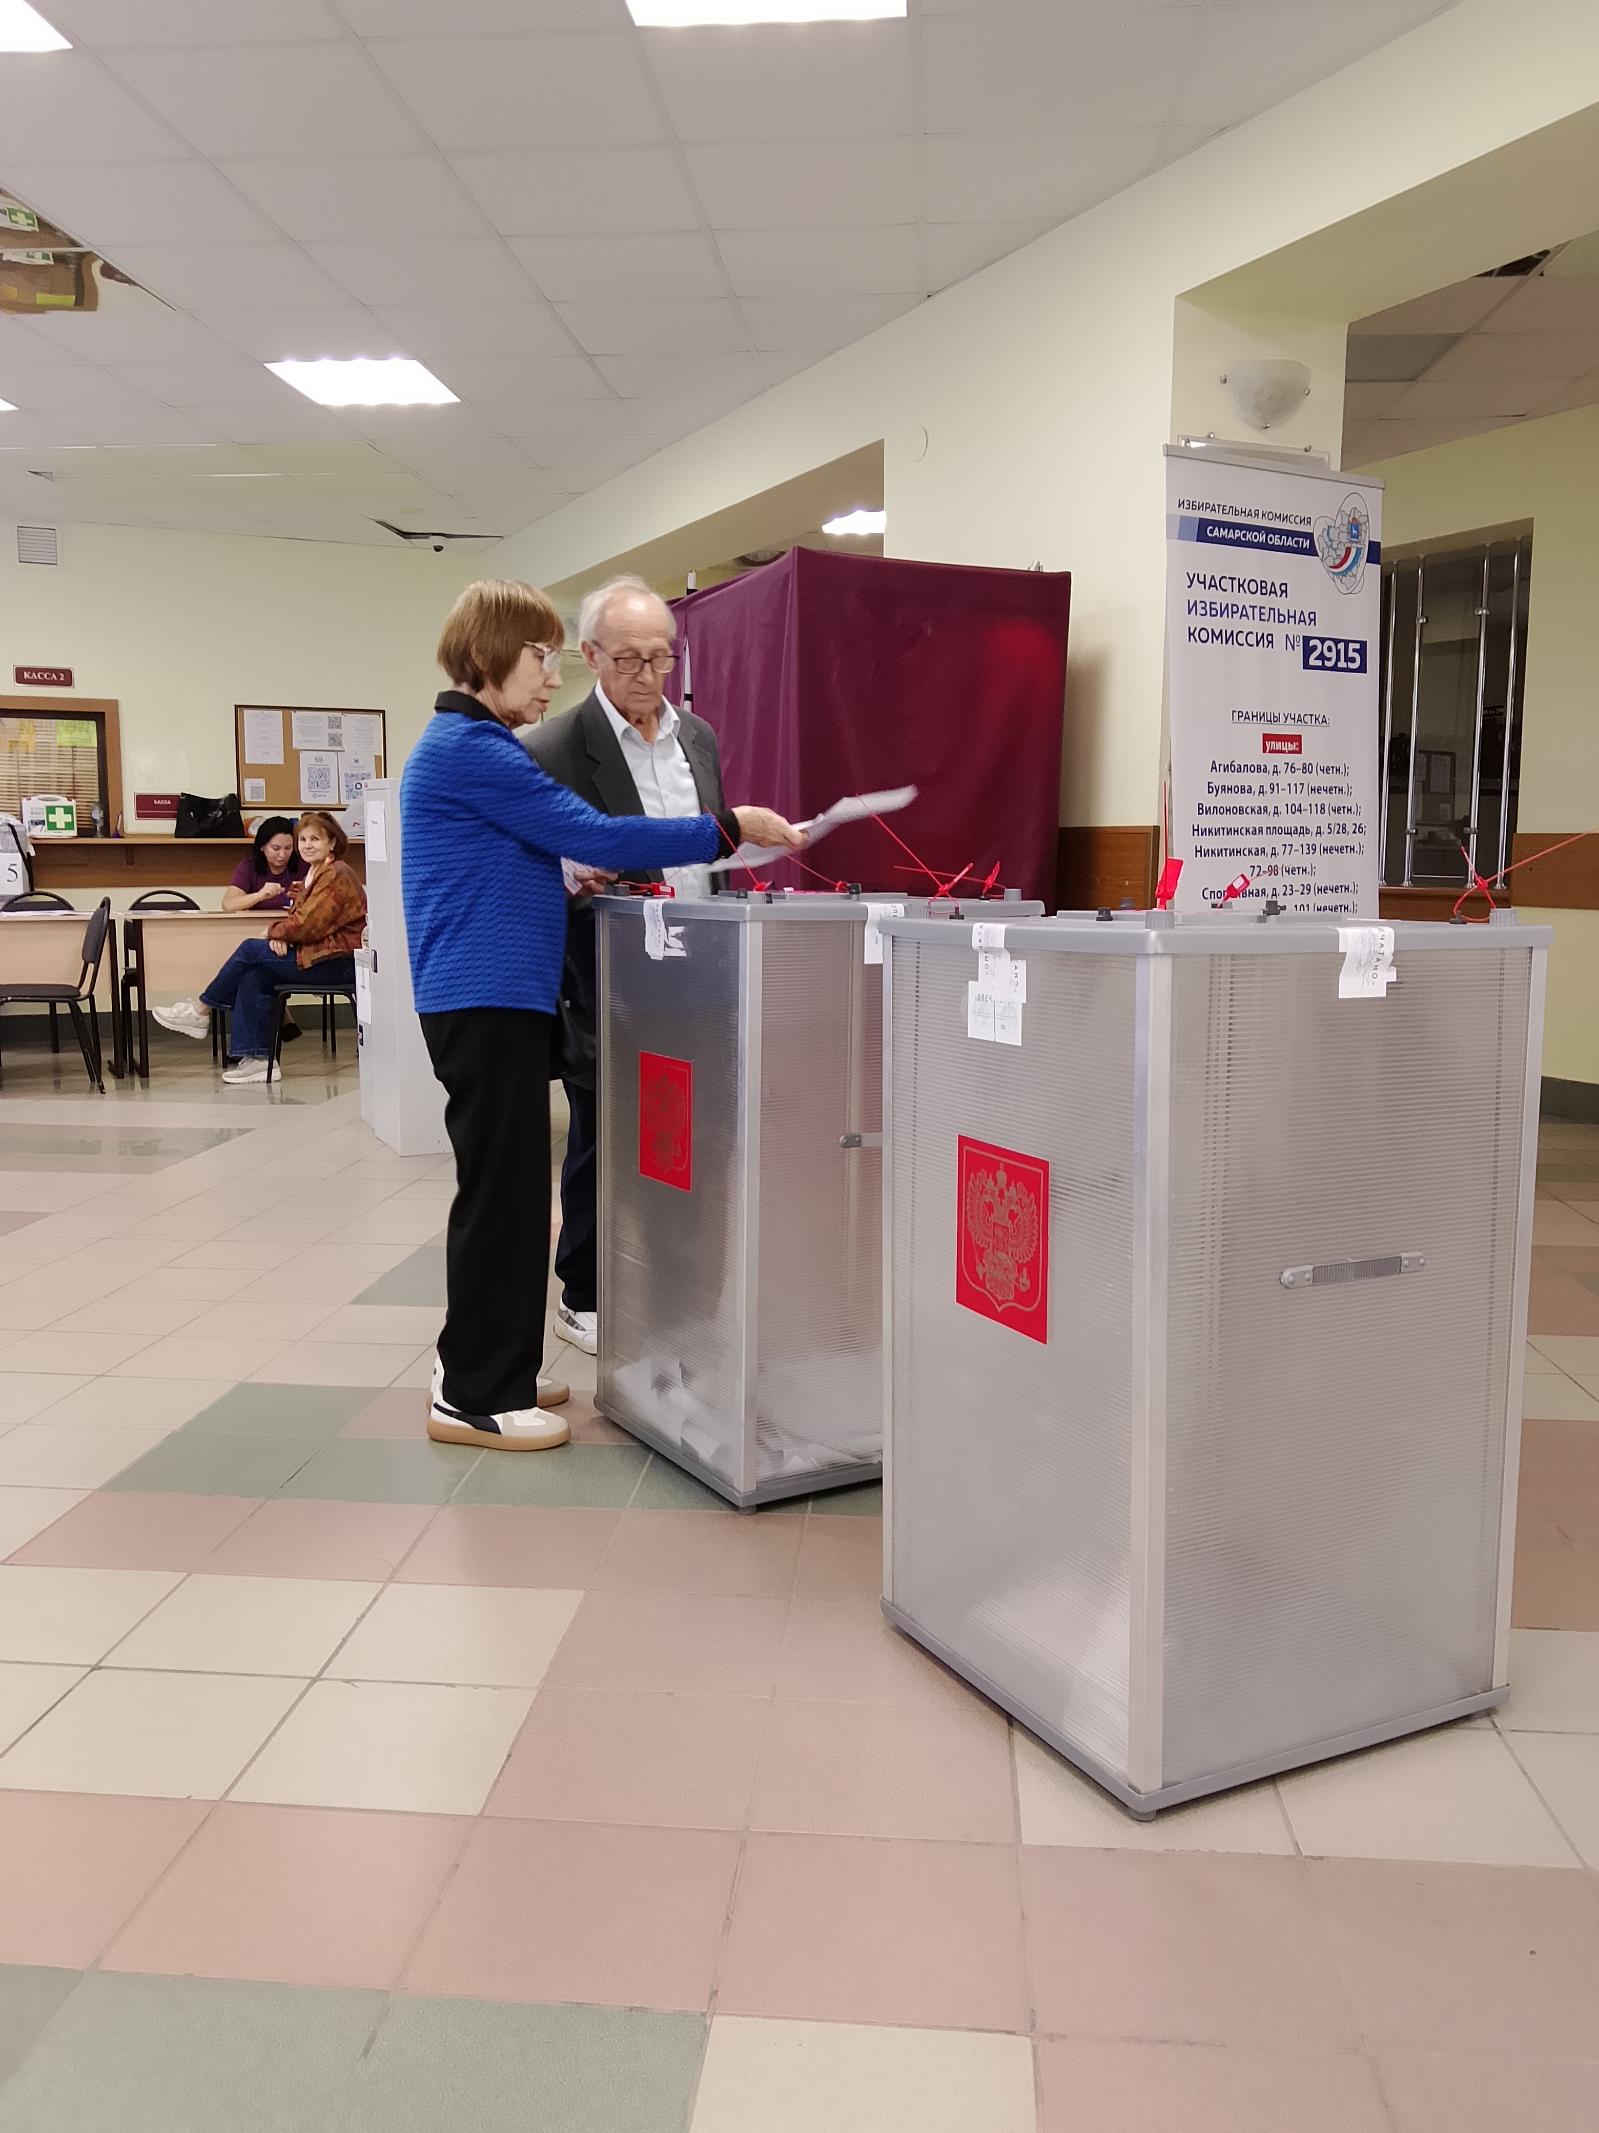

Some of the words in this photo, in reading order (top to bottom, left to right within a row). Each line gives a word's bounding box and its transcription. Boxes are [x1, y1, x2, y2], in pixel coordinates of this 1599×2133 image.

[1178, 499, 1259, 519] ИЗБИРАТЕЛЬНАЯ
[1261, 511, 1312, 526] КОМИССИЯ
[1206, 526, 1265, 543] САМАРСКОЙ
[1267, 533, 1310, 549] ОБЛАСТИ
[1186, 571, 1288, 598] УЧАСТКОВАЯ
[1187, 599, 1317, 626] ИЗБИРАТЕЛЬНАЯ
[1187, 627, 1274, 649] КОМИССИЯ
[1308, 639, 1361, 669] 2915
[23, 671, 58, 681] КАССА
[59, 672, 65, 681] 2
[1232, 710, 1281, 724] ГРАНИЦЫ
[1283, 712, 1330, 725] УЧАСТКА:
[1265, 739, 1299, 752] улицы:
[1210, 760, 1270, 776] Агибалова,
[1272, 764, 1282, 776] д.
[1315, 762, 1350, 776] (четн.);
[1207, 782, 1256, 797] Буянова,
[1258, 786, 1268, 797] д.
[1307, 783, 1353, 797] (нечетн.);
[1197, 803, 1271, 817] Вилоновская,
[1273, 806, 1282, 817] д.
[1328, 802, 1362, 817] (четн.);
[1192, 824, 1264, 837] Никитинская
[1266, 825, 1313, 838] площадь,
[1315, 825, 1325, 837] д.
[1327, 823, 1350, 837] 5/28,
[1352, 823, 1367, 837] 26;
[1195, 845, 1269, 859] Никитинская,
[1271, 847, 1280, 858] д.
[1319, 842, 1364, 857] (нечетн.);
[7, 864, 19, 883] 5
[1281, 864, 1316, 877] (четн.);
[1202, 887, 1269, 901] Сповная,
[1271, 888, 1280, 899] д.
[1314, 882, 1359, 897] (нечетн.);
